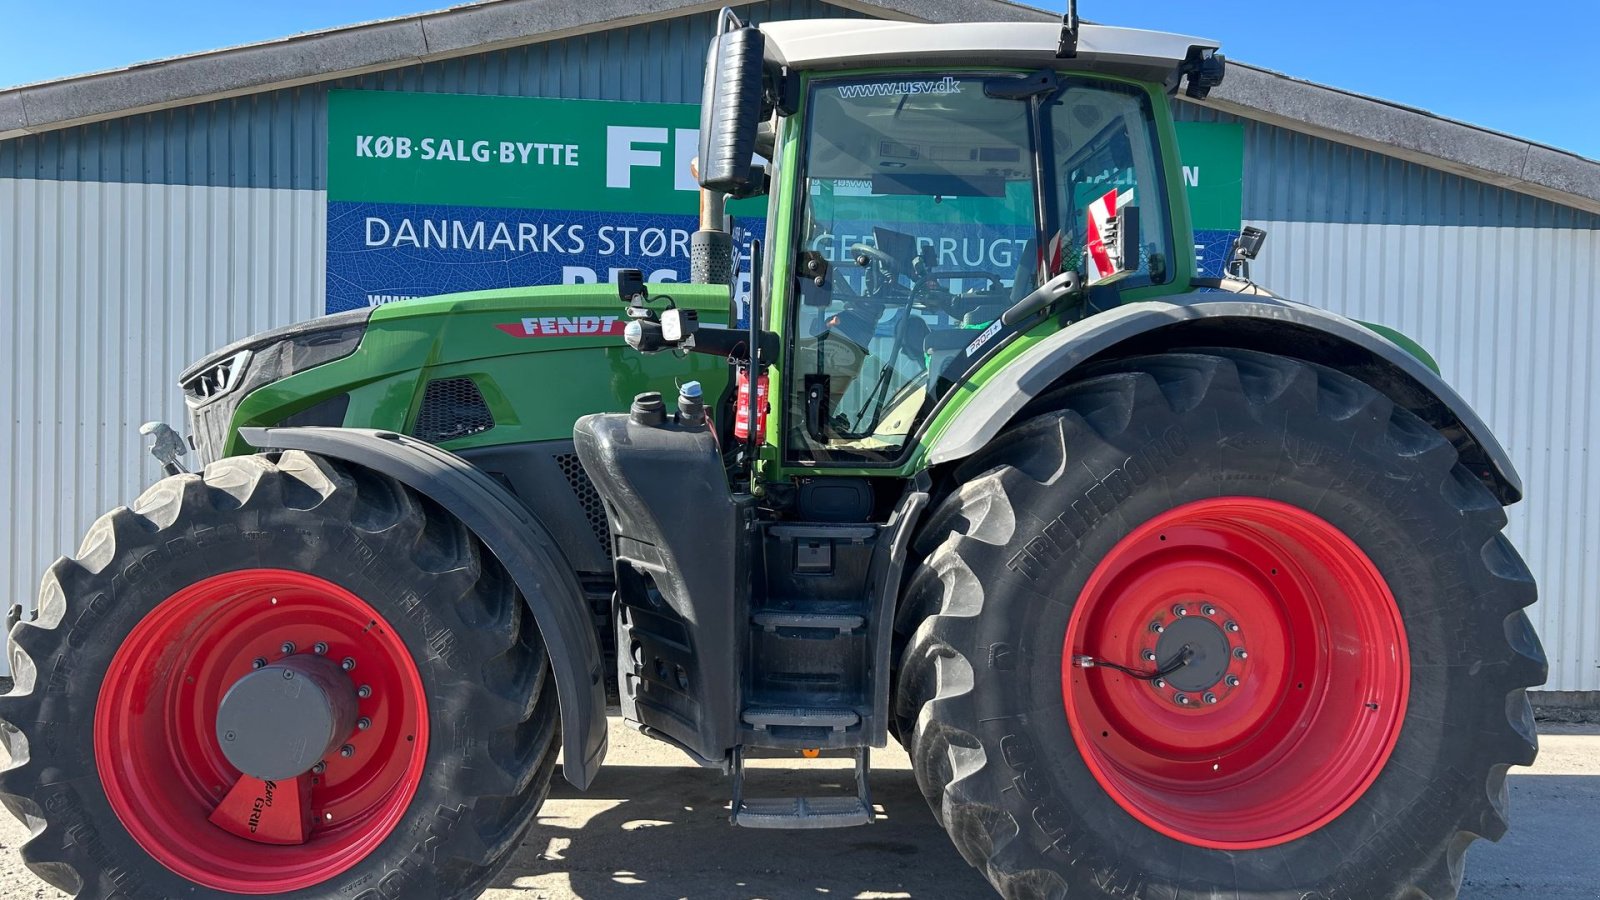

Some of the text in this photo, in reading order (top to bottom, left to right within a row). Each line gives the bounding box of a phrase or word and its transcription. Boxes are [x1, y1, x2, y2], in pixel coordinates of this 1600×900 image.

[838, 76, 961, 98] www.usv.dk
[365, 217, 585, 253] DANMARKS
[521, 316, 619, 335] FENDT
[248, 797, 266, 834] GRIP
